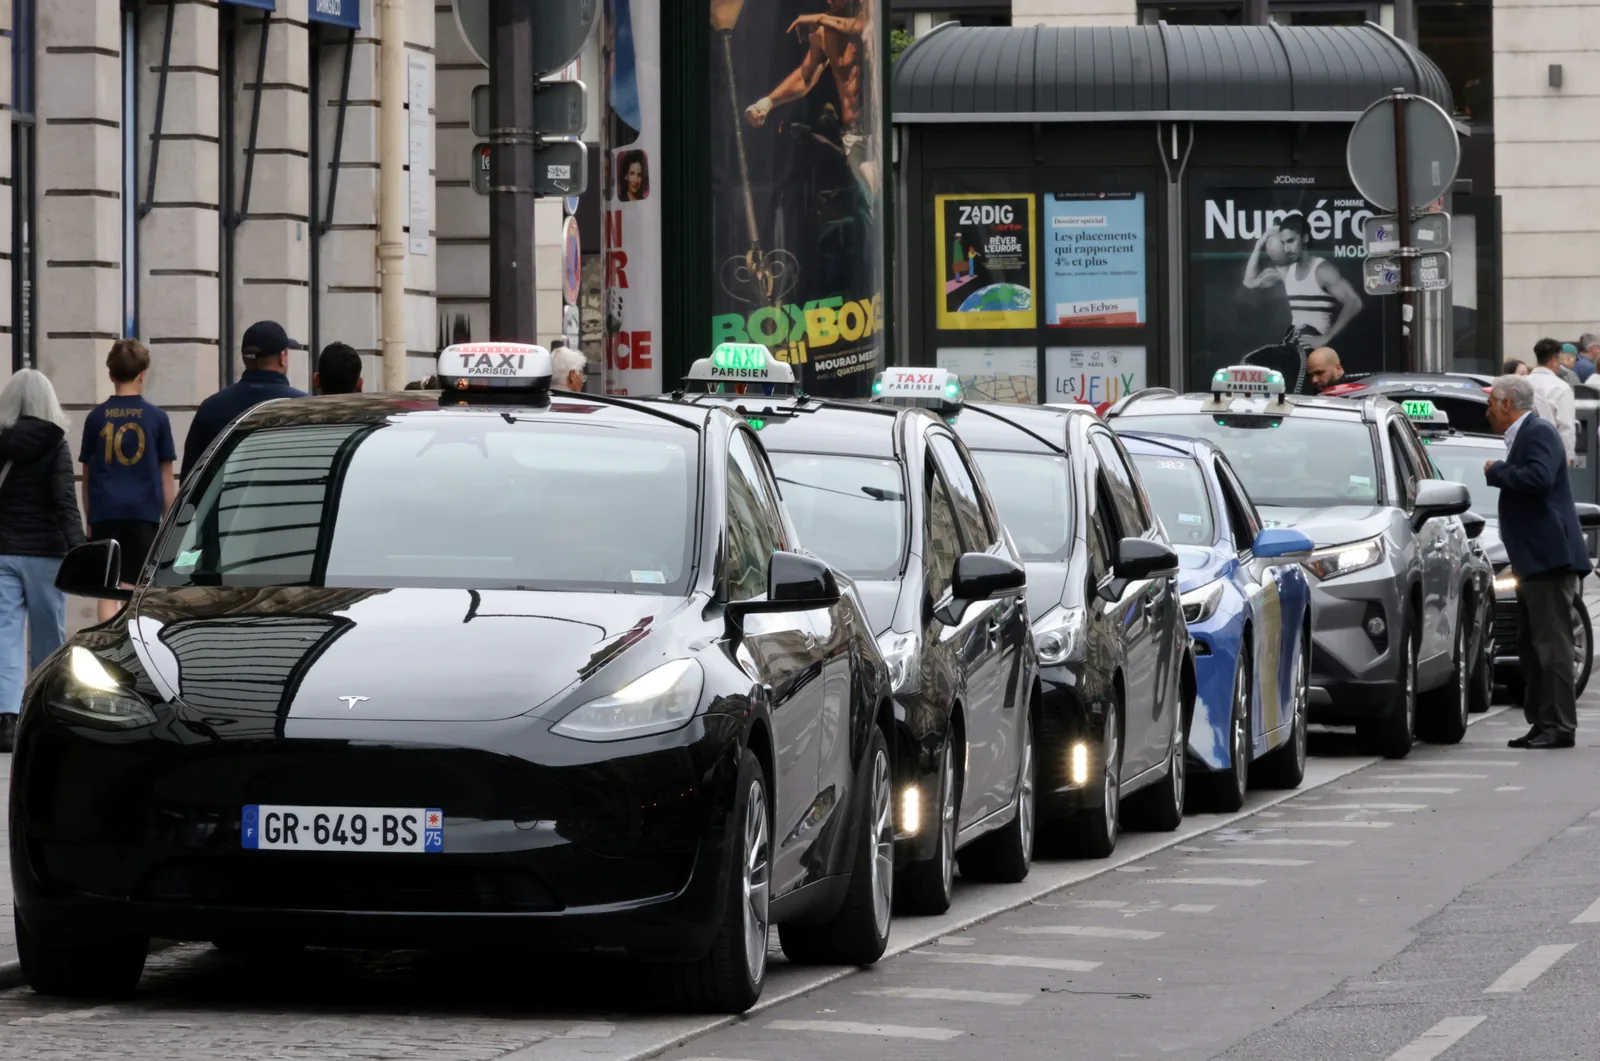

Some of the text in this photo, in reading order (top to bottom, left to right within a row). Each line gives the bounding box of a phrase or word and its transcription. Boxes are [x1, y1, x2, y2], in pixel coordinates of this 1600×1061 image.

[1274, 175, 1315, 184] JCDecaux
[1334, 199, 1365, 207] HOMME
[959, 205, 1014, 225] ZADIG
[1080, 217, 1104, 226] spécial
[989, 235, 1017, 245] RÊVER
[1055, 231, 1137, 243] Les placements
[984, 244, 1022, 253] L'EUROPE
[1054, 244, 1134, 256] qui rapportent
[1334, 245, 1367, 257] MOD
[1055, 256, 1108, 268] 4% et plus
[1073, 302, 1119, 313] Les Echos
[459, 353, 525, 369] TAXI
[718, 346, 763, 368] TAXI
[815, 355, 857, 372] MOURAD
[468, 367, 517, 375] PARISIEN
[711, 367, 769, 378] PARISIEN
[1231, 370, 1263, 382] TAXI
[895, 373, 934, 383] TAXI
[889, 383, 941, 391] PARISIEN
[1056, 373, 1135, 404] LES JEUX
[1227, 383, 1268, 391] PARISIEN
[1405, 402, 1430, 415] TAXI
[100, 422, 145, 466] 10
[1156, 460, 1186, 470] 382
[247, 812, 442, 846] F GR-649-BS 75
